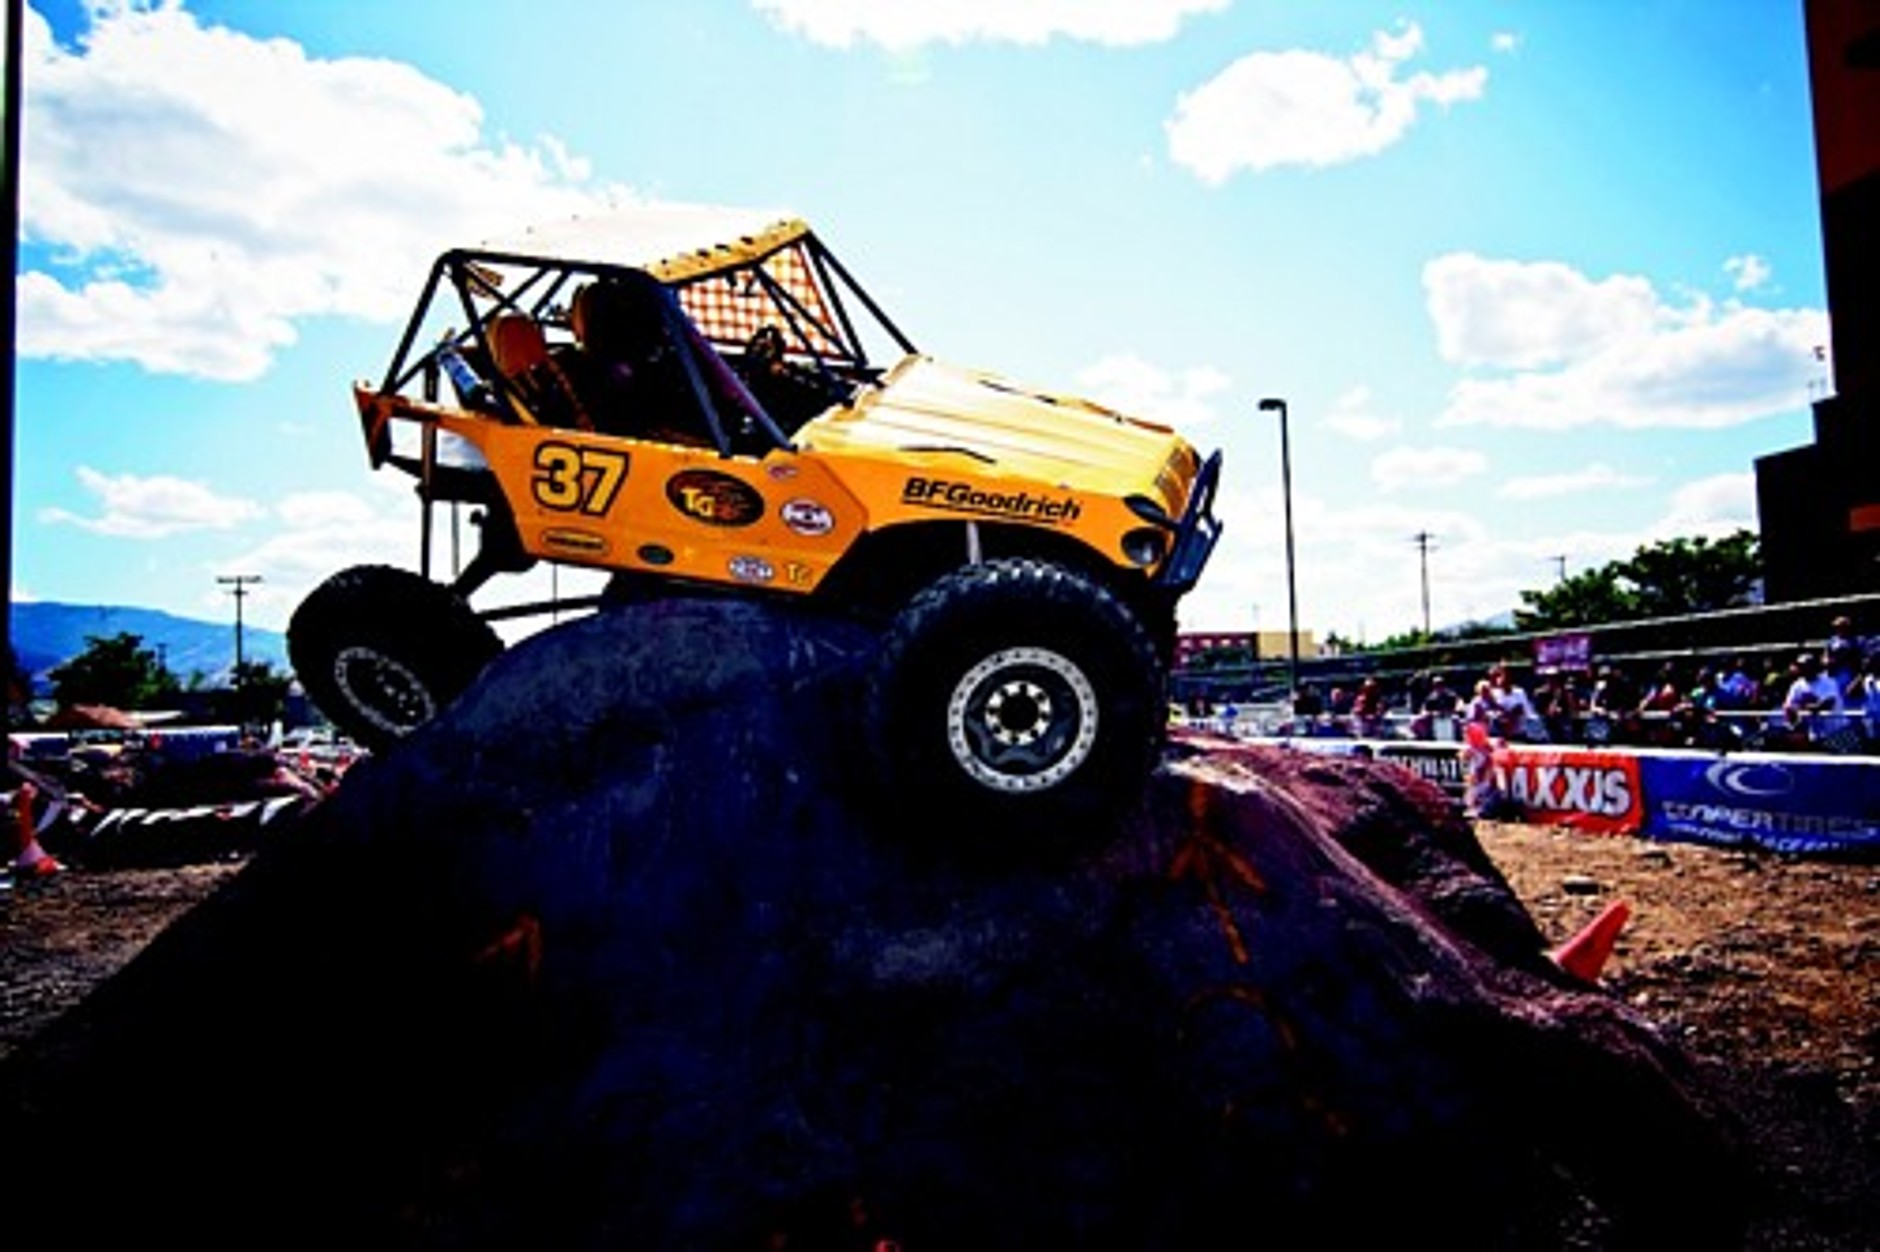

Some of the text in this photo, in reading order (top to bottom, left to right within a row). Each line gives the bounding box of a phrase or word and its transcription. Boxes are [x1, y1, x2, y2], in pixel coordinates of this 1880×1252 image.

[532, 441, 629, 517] 37
[903, 476, 1081, 521] BFGoodrich
[1503, 765, 1630, 816] AXXIS
